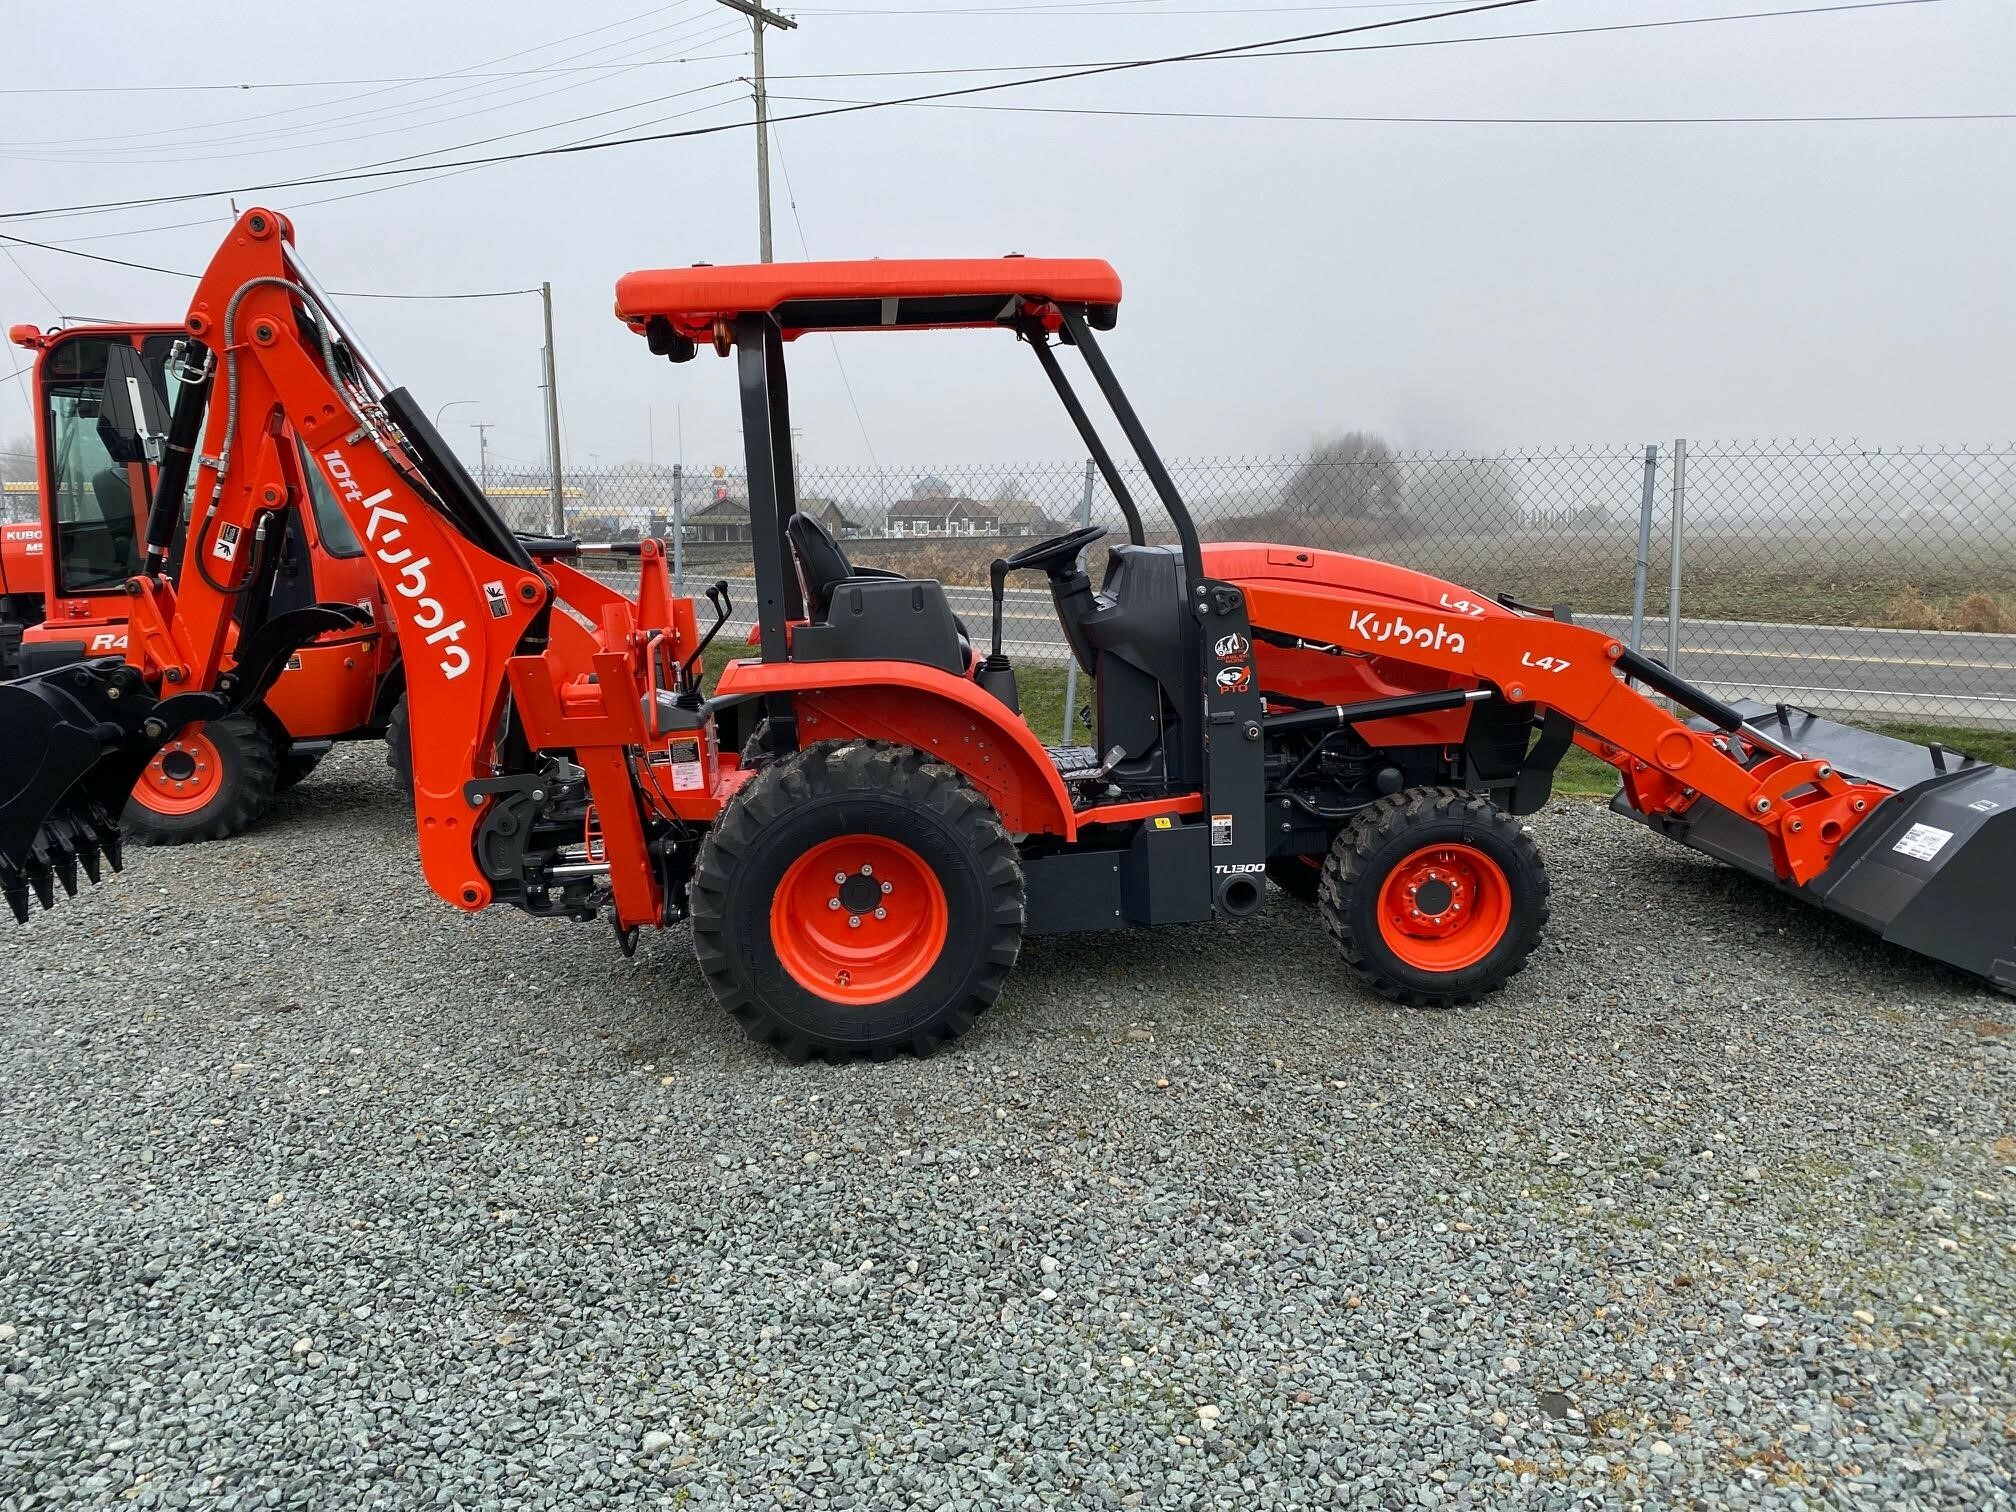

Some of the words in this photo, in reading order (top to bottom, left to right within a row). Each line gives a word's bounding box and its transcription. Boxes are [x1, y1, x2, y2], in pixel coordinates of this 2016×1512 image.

[323, 450, 363, 502] 10ft
[362, 488, 470, 680] Kubota
[1440, 593, 1486, 617] L47
[1349, 610, 1465, 653] Kubota
[1521, 651, 1571, 673] L47
[1220, 684, 1248, 693] PTO
[1214, 863, 1266, 874] TL1300
